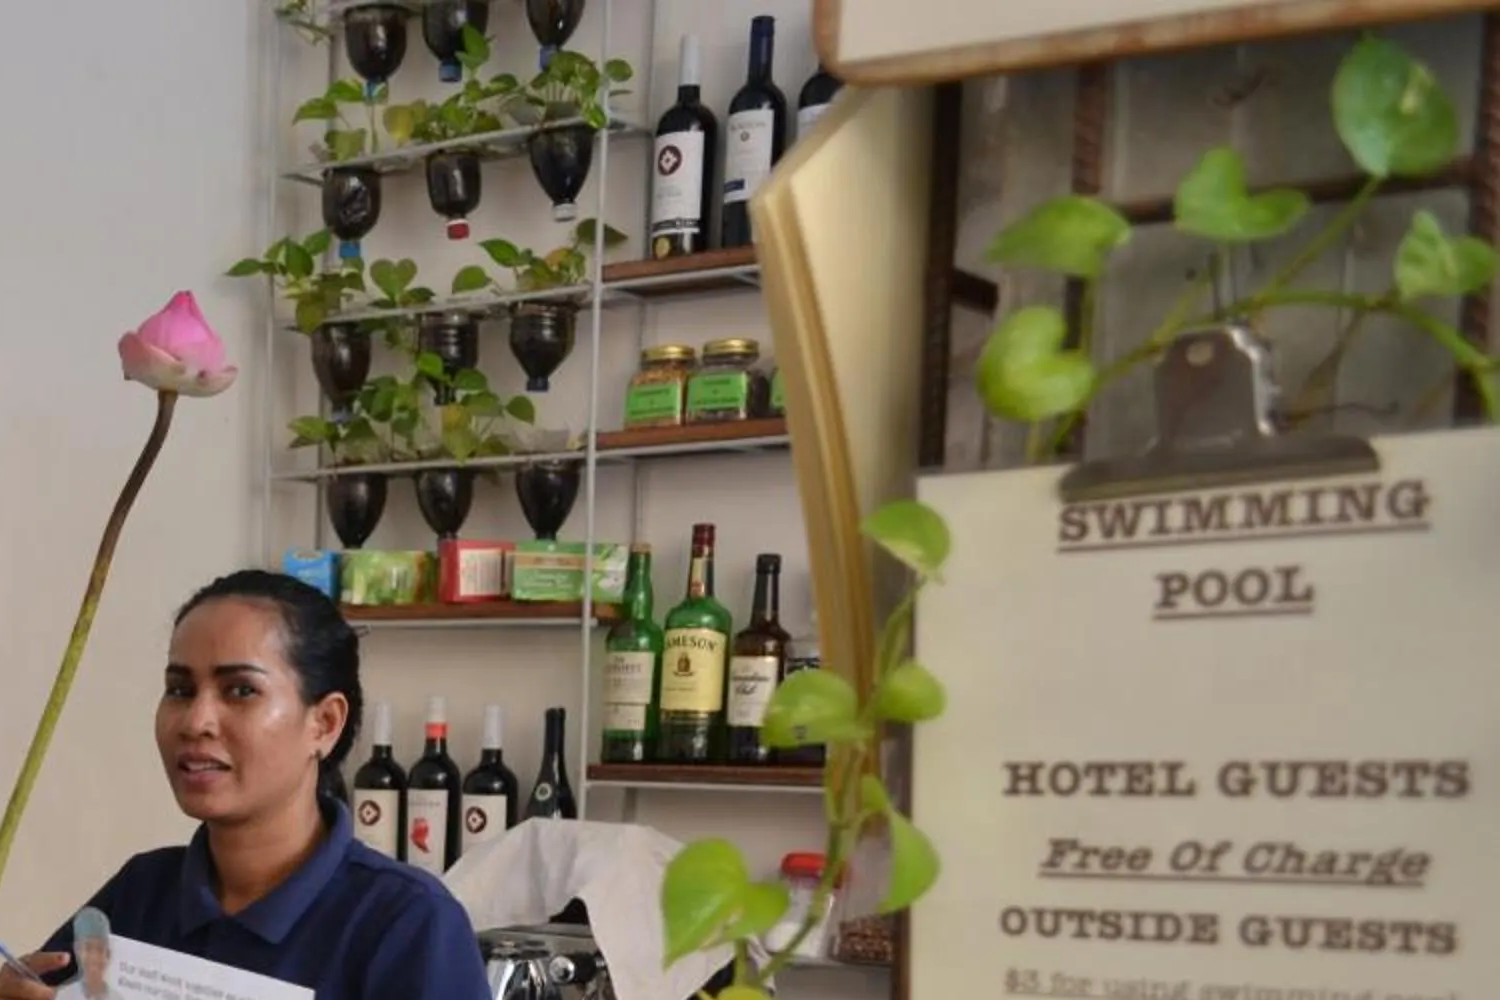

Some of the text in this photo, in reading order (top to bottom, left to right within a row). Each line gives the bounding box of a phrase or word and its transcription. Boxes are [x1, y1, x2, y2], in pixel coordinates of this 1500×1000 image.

[1059, 481, 1431, 543] SWIMMING
[1154, 566, 1314, 609] POOL
[665, 634, 719, 651] AMESON
[1002, 761, 1470, 799] HOTEL GUESTS
[1040, 836, 1431, 885] Free Of Charge
[1000, 906, 1459, 955] OUTSIDE GUESTS
[1005, 967, 1039, 996] $3
[1050, 968, 1093, 997] for
